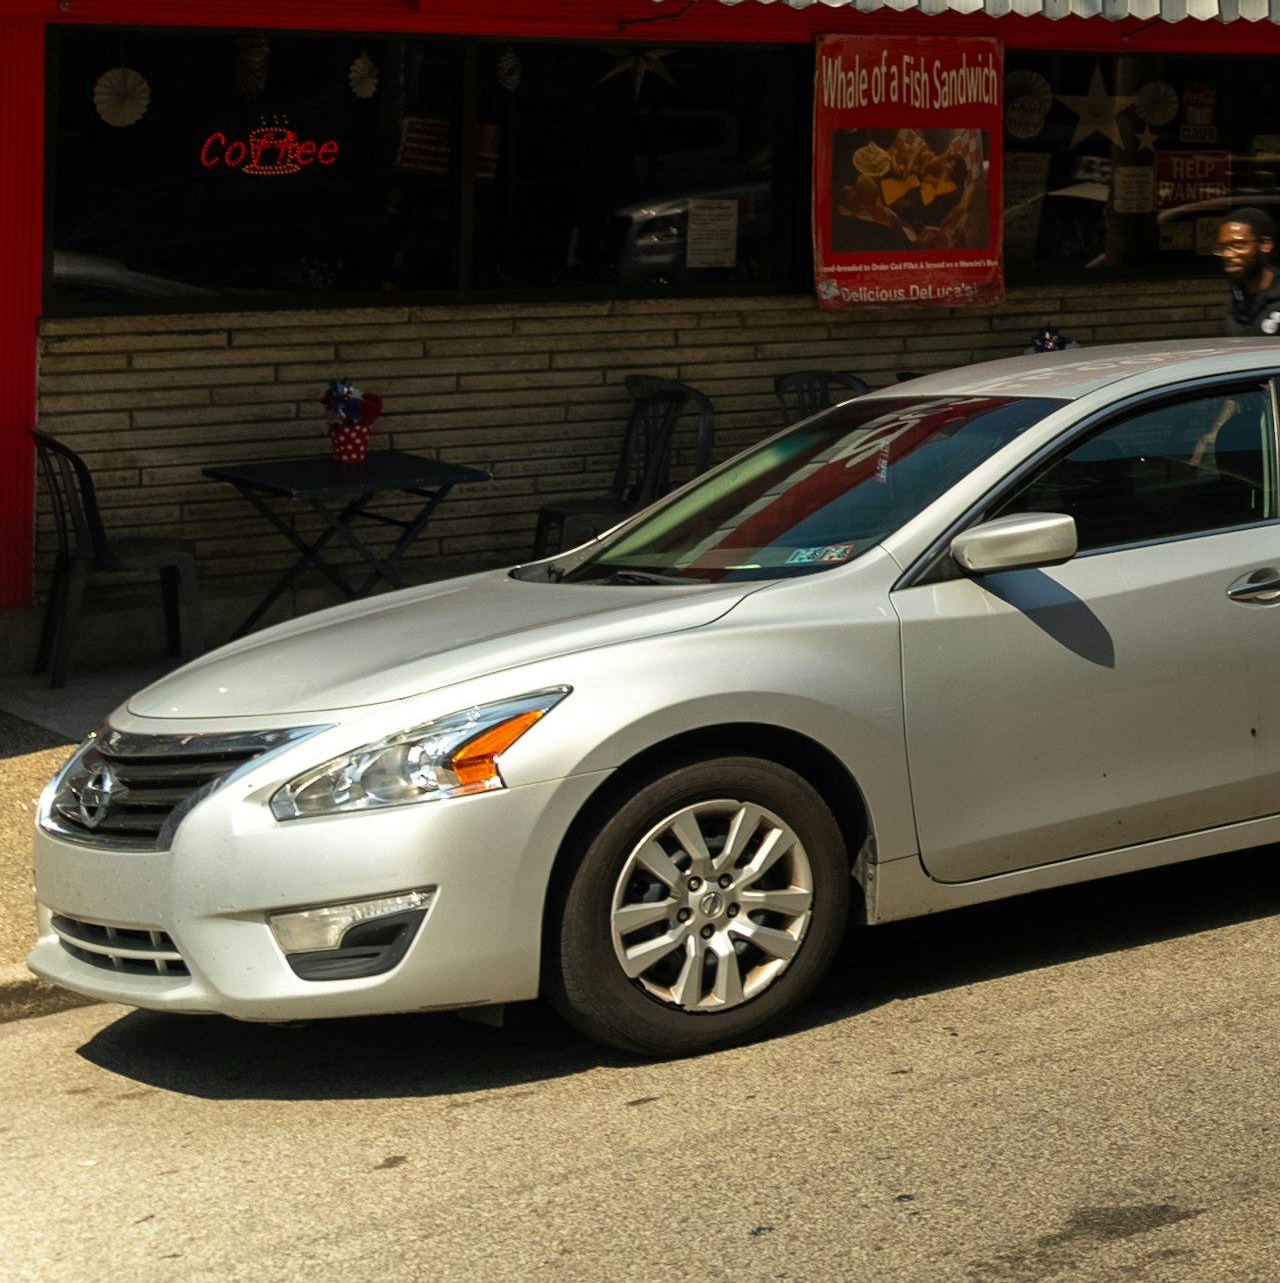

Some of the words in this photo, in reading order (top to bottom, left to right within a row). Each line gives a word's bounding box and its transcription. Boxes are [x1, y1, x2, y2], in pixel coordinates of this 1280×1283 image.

[822, 54, 868, 109] Whale
[872, 49, 888, 105] of
[890, 65, 899, 102] a
[903, 54, 930, 109] Fish
[933, 52, 998, 109] Sandwich
[1182, 127, 1216, 141] CLOSED
[200, 130, 339, 168] Coffee
[1172, 157, 1216, 179] HELP
[1158, 182, 1227, 201] WANTED
[841, 286, 906, 302] Delicious
